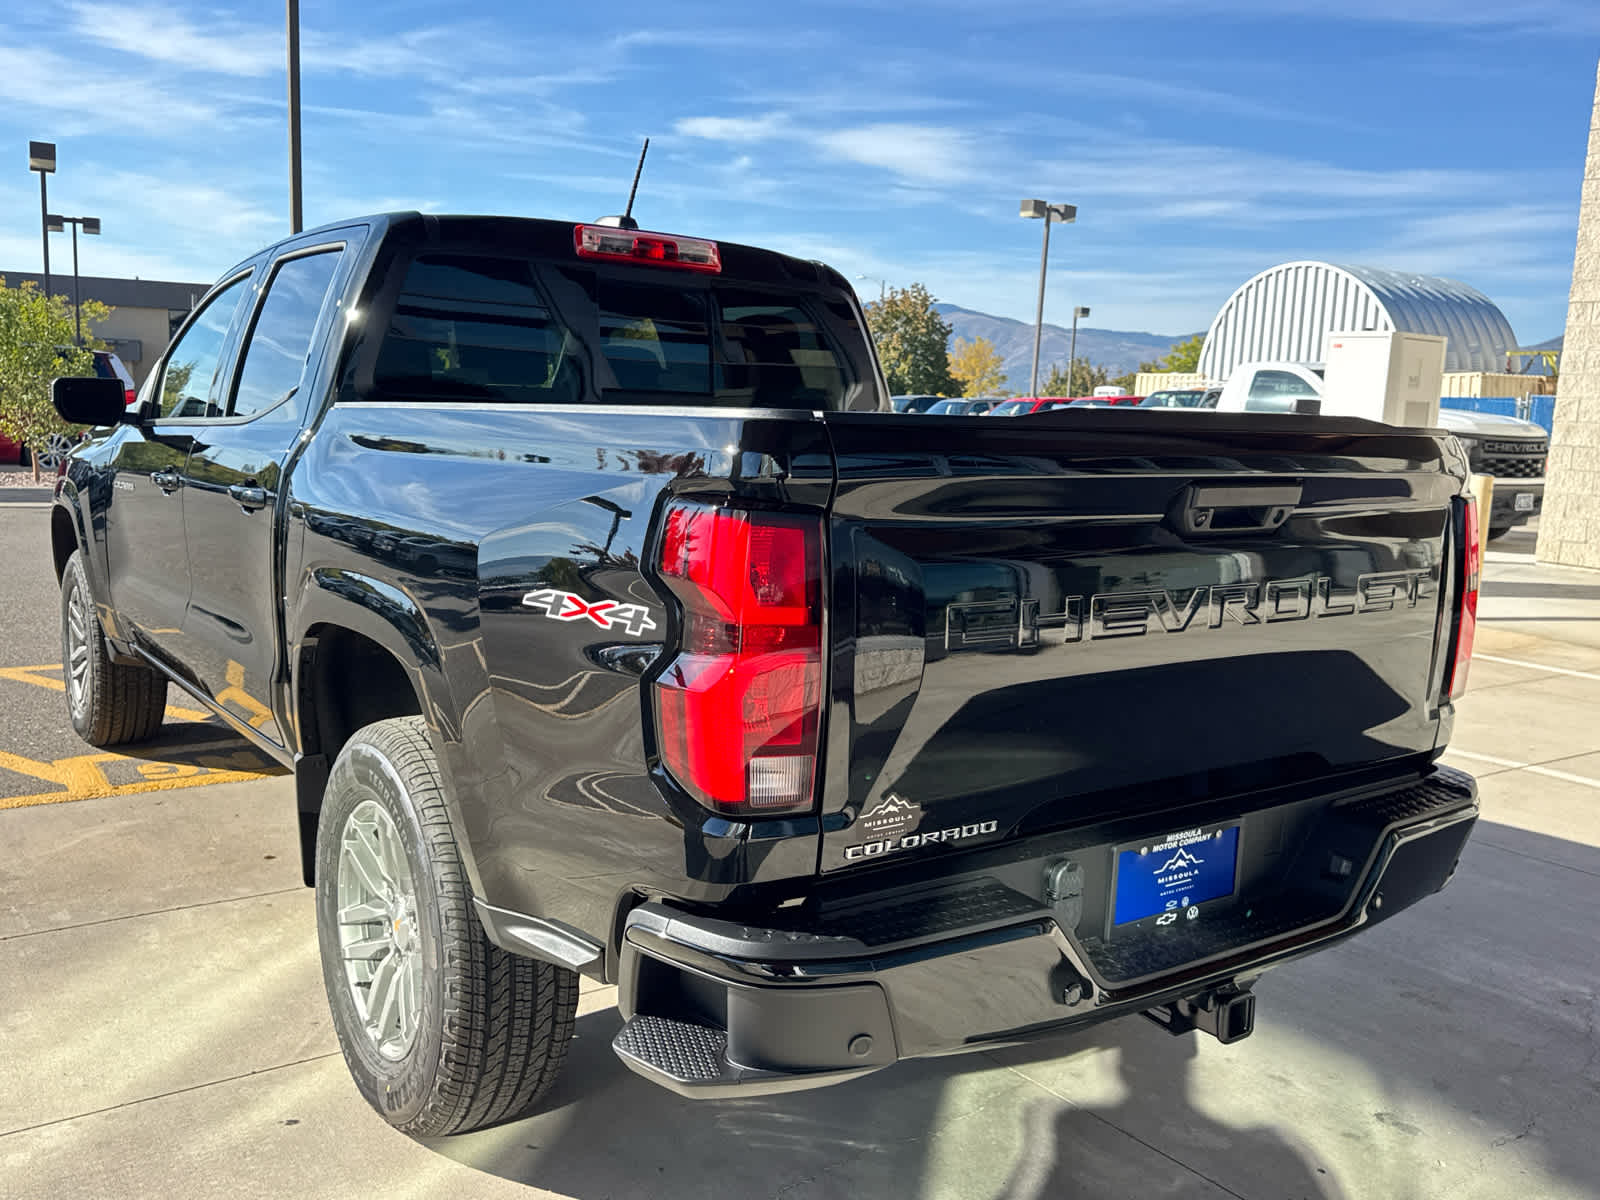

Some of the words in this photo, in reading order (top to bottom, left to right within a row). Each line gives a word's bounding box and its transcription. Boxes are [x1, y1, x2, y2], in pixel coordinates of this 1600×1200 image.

[944, 568, 1433, 651] CHEVROLET
[863, 814, 913, 828] MISSOULA
[845, 819, 998, 860] COLORADO
[1152, 841, 1178, 853] MOTOR
[1178, 833, 1212, 847] COMPANY
[1166, 828, 1202, 843] MISSOULA
[1157, 869, 1199, 885] MISSOULA
